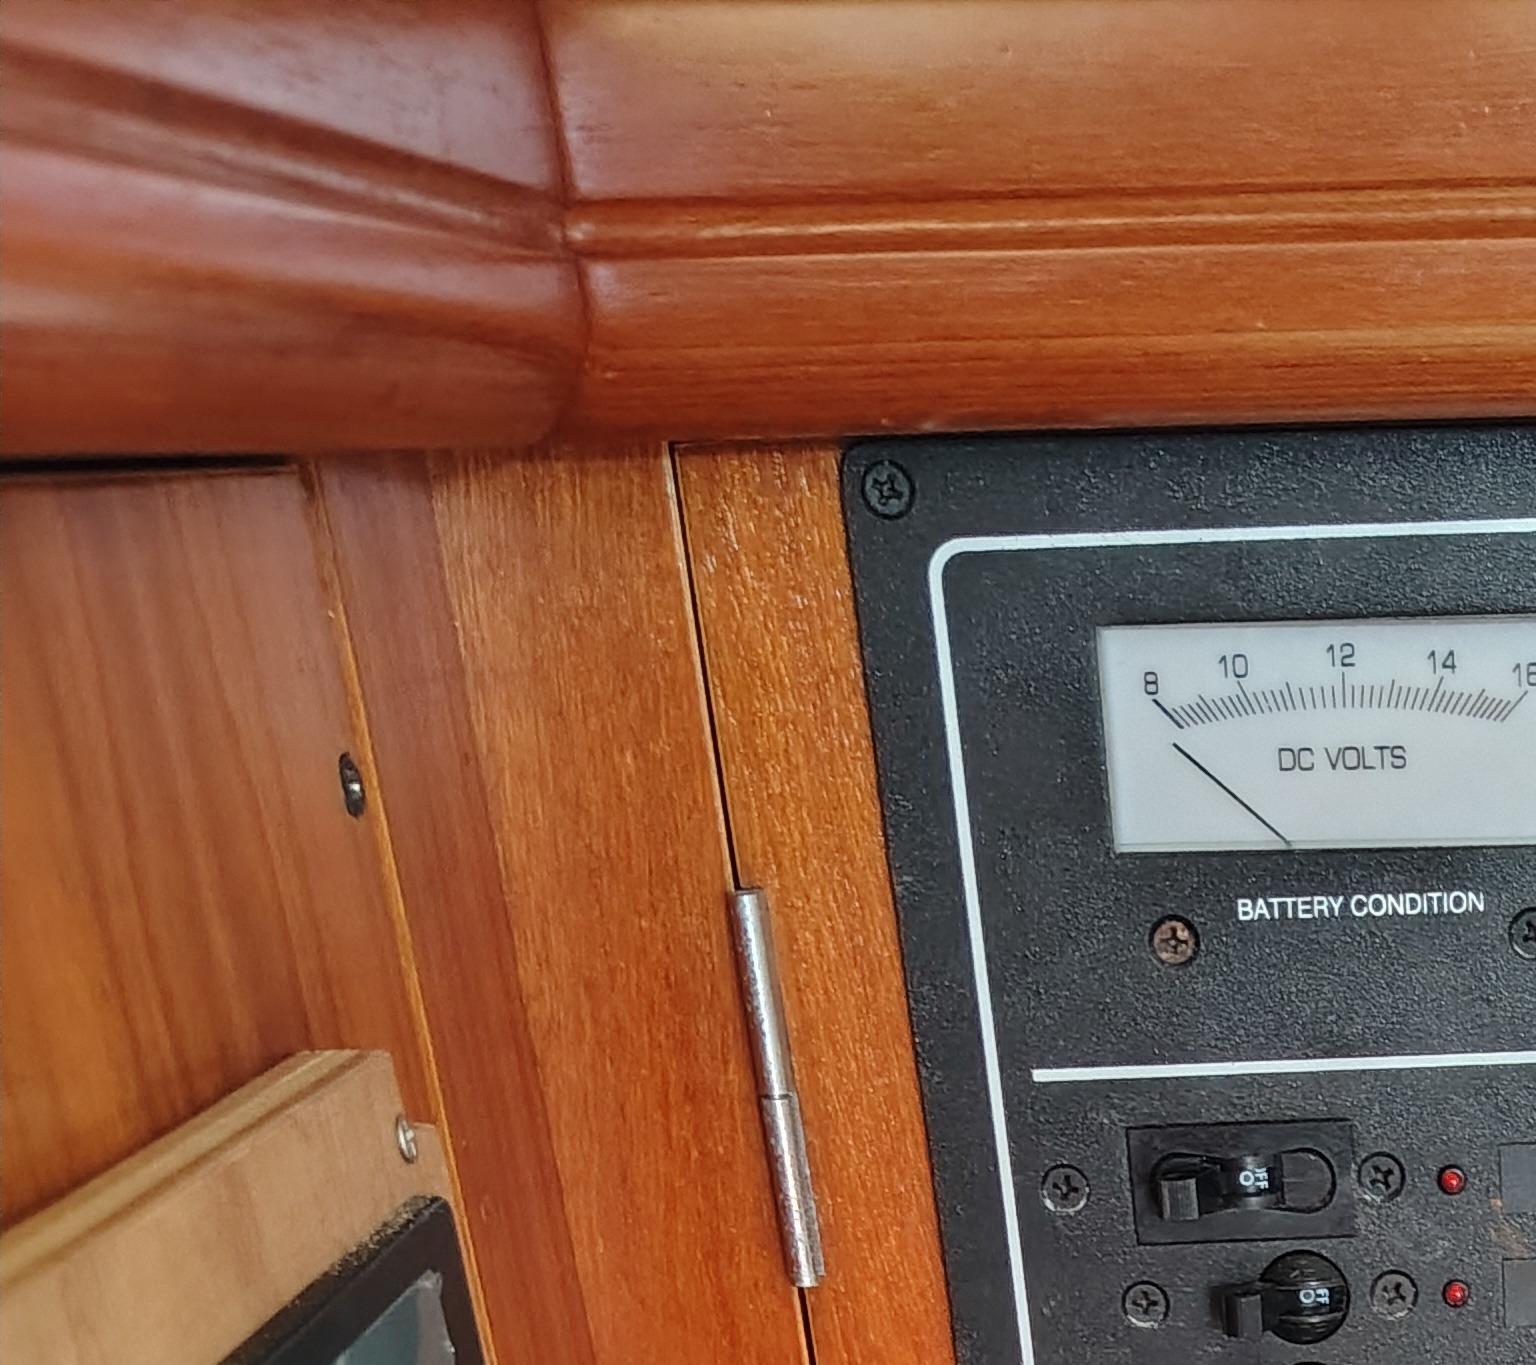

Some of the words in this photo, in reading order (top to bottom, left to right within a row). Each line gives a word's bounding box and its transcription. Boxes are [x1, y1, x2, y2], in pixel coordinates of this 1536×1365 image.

[1219, 654, 1249, 678] 10
[1326, 644, 1355, 667] 12
[1427, 651, 1456, 674] 14
[1144, 673, 1159, 696] 8
[1278, 747, 1314, 772] DC
[1325, 746, 1407, 770] VOLTS
[1237, 897, 1344, 920] BATTERY
[1350, 892, 1484, 917] CONDITION
